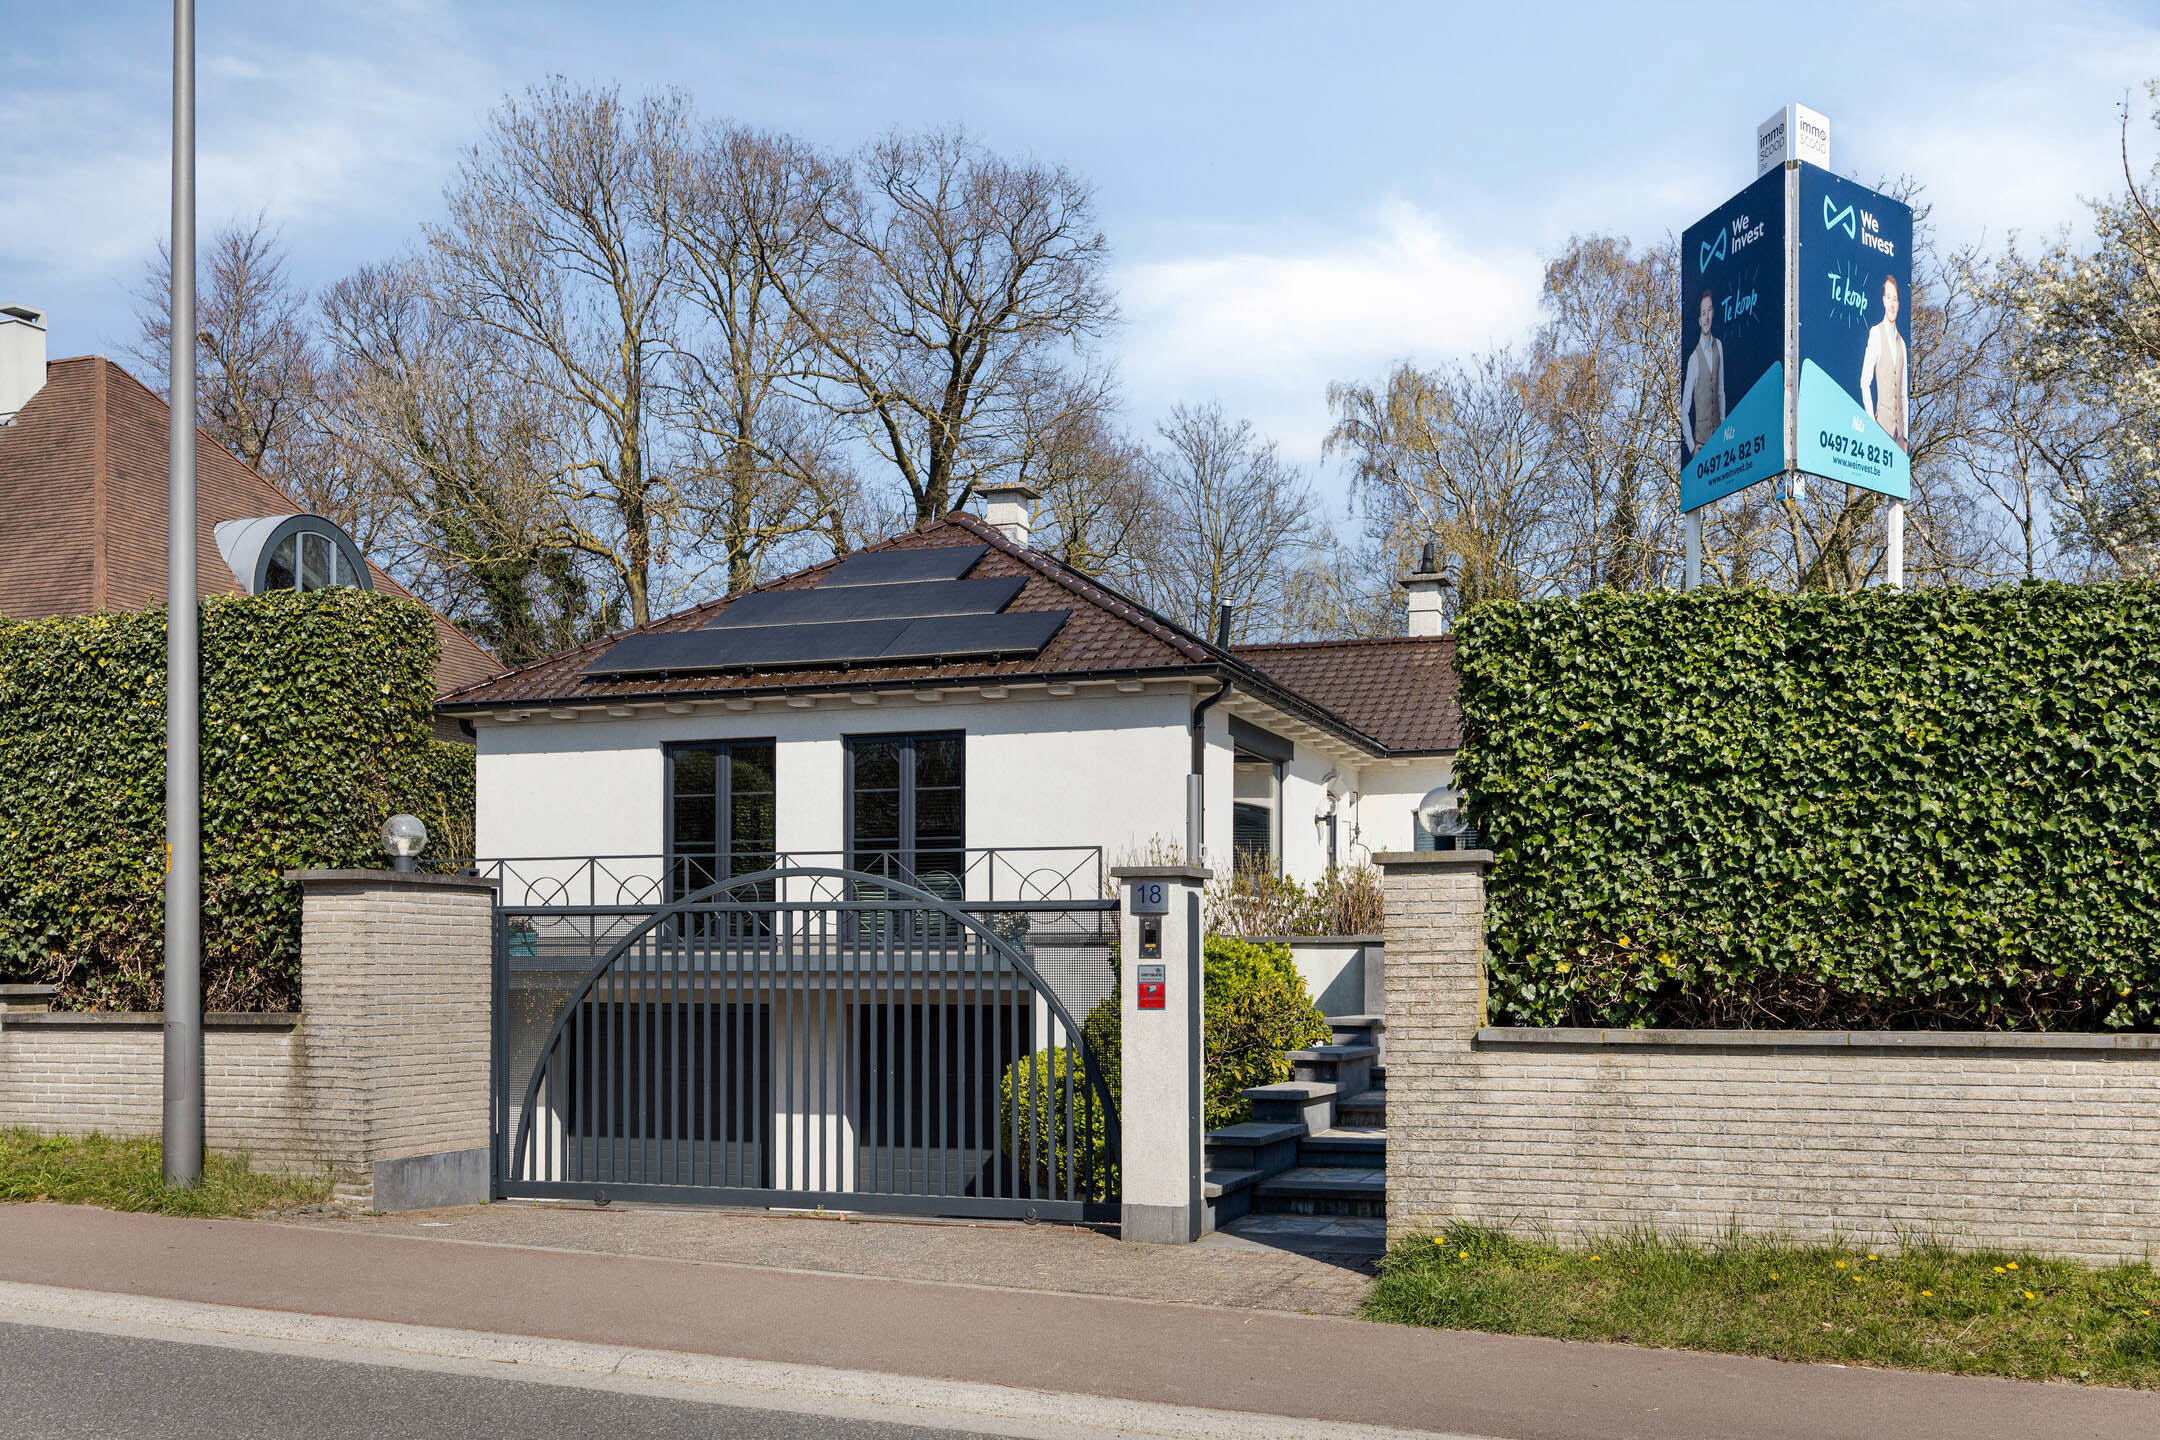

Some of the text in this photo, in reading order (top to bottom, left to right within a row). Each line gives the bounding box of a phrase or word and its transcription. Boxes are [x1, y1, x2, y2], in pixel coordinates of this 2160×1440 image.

[1760, 122, 1785, 149] immo
[1800, 115, 1827, 141] immo
[1760, 136, 1785, 162] scoop
[1800, 133, 1826, 154] scoop
[1732, 214, 1749, 236] We
[1860, 208, 1879, 233] We
[1731, 221, 1764, 255] Invest
[1861, 227, 1894, 257] Invest
[1721, 288, 1758, 324] Te koop
[1827, 272, 1868, 316] Te koop
[1697, 433, 1766, 479] 0497 24 82 51
[1819, 430, 1893, 469] 0497 24 82 51
[1708, 460, 1753, 486] www.weinvest.be
[1832, 456, 1881, 477] www.weinvest.be
[1137, 884, 1162, 904] 18
